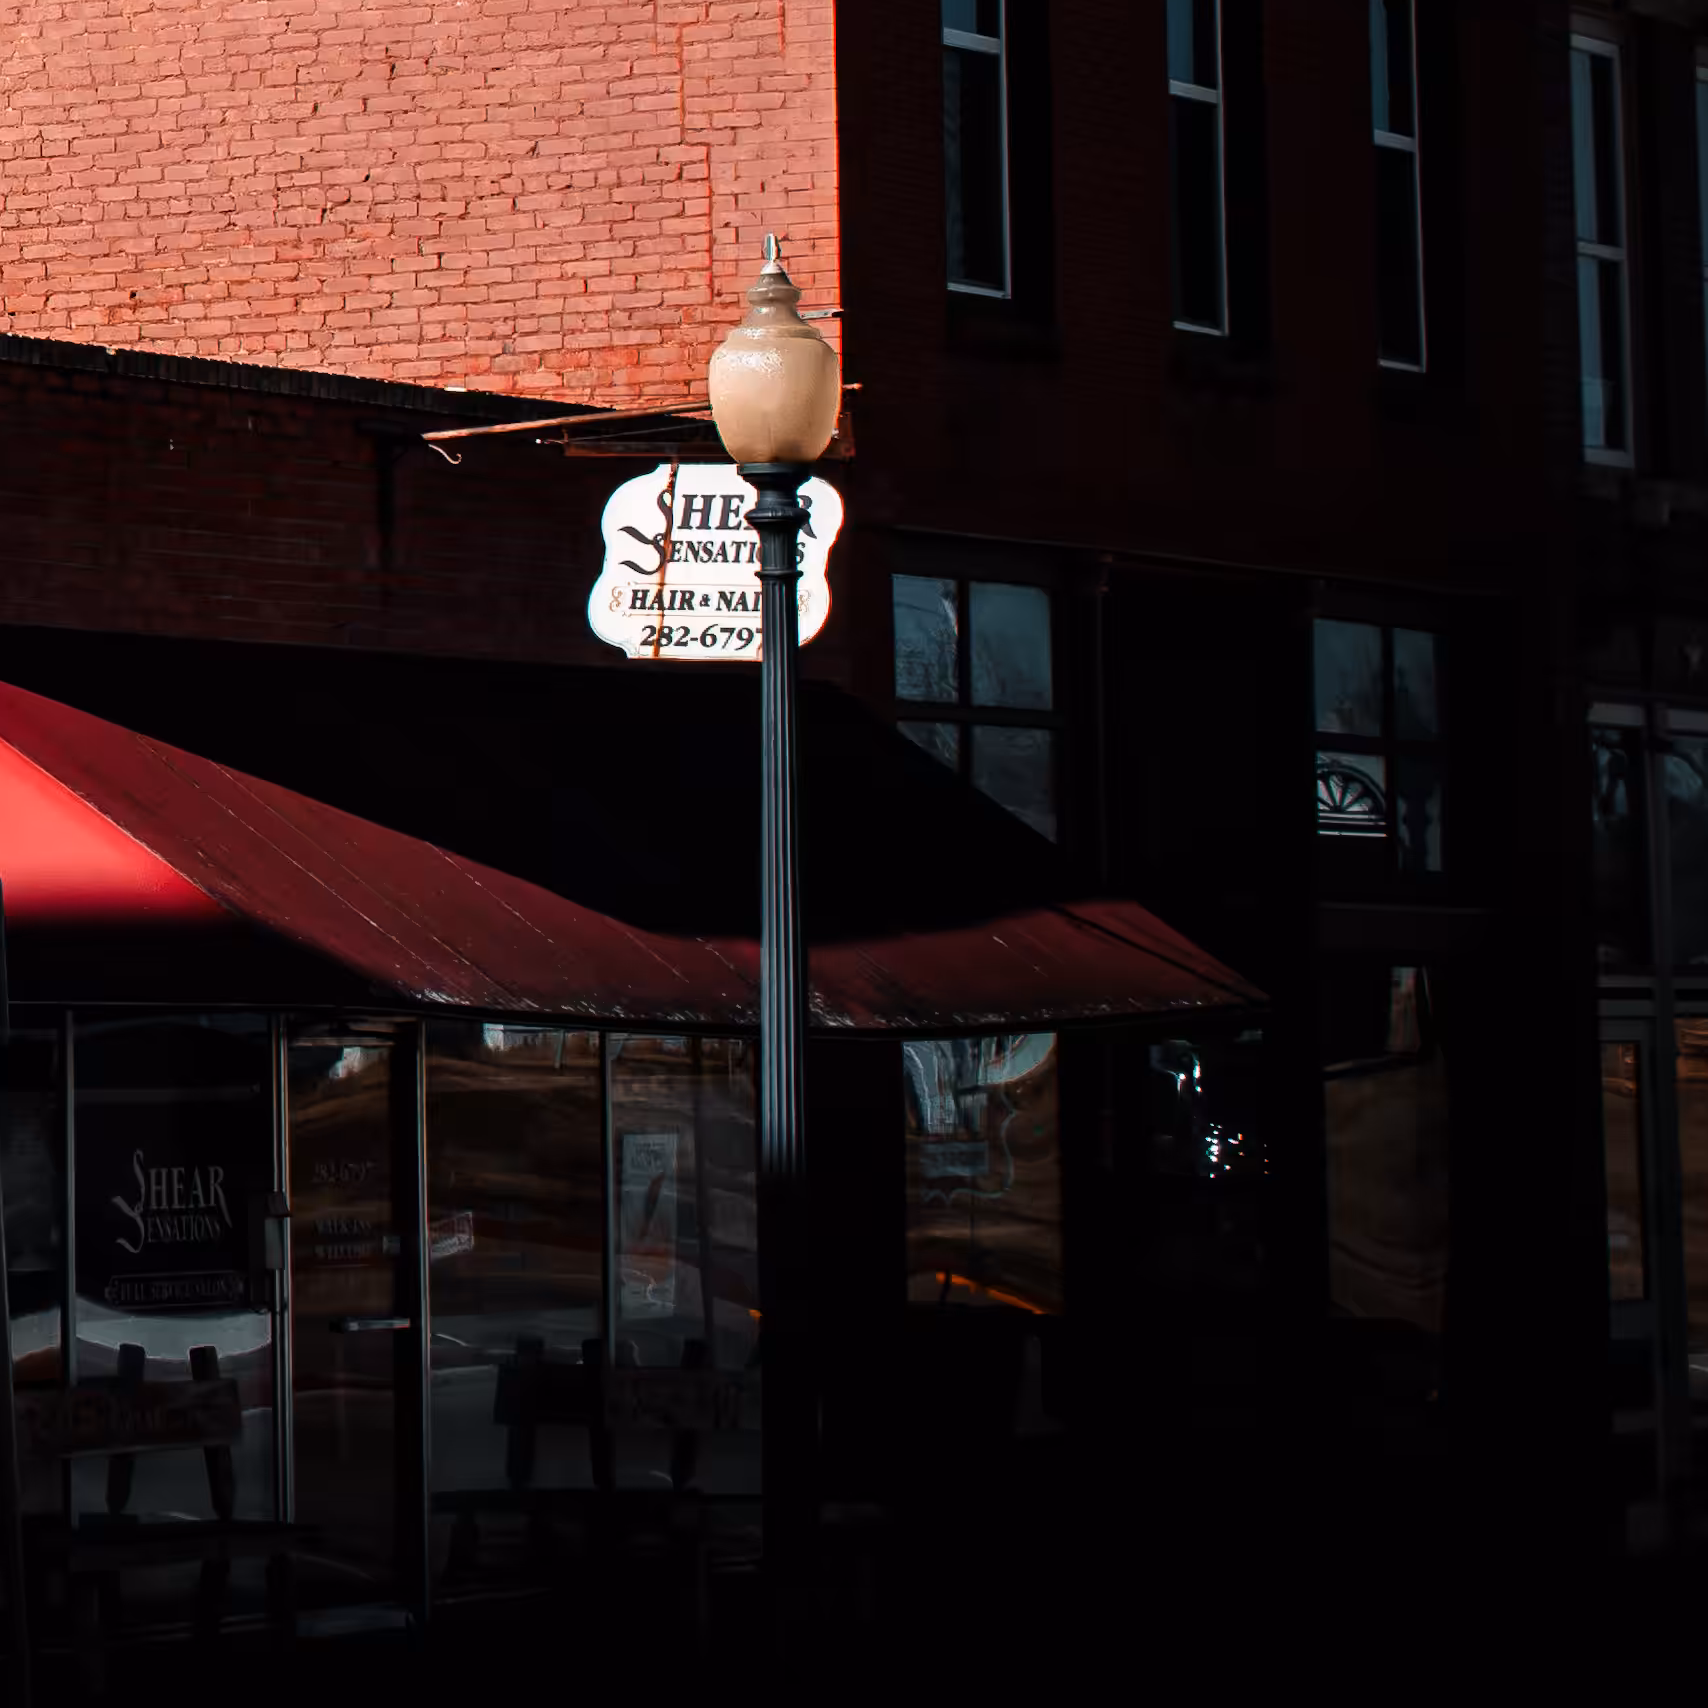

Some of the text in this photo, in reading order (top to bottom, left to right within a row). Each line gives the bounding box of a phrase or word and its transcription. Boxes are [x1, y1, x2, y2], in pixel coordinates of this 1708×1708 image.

[618, 489, 817, 544] SHER
[618, 533, 806, 575] SENSATIS
[629, 589, 695, 612] HAIR
[699, 593, 711, 608] &
[111, 1149, 233, 1229] SHEAR
